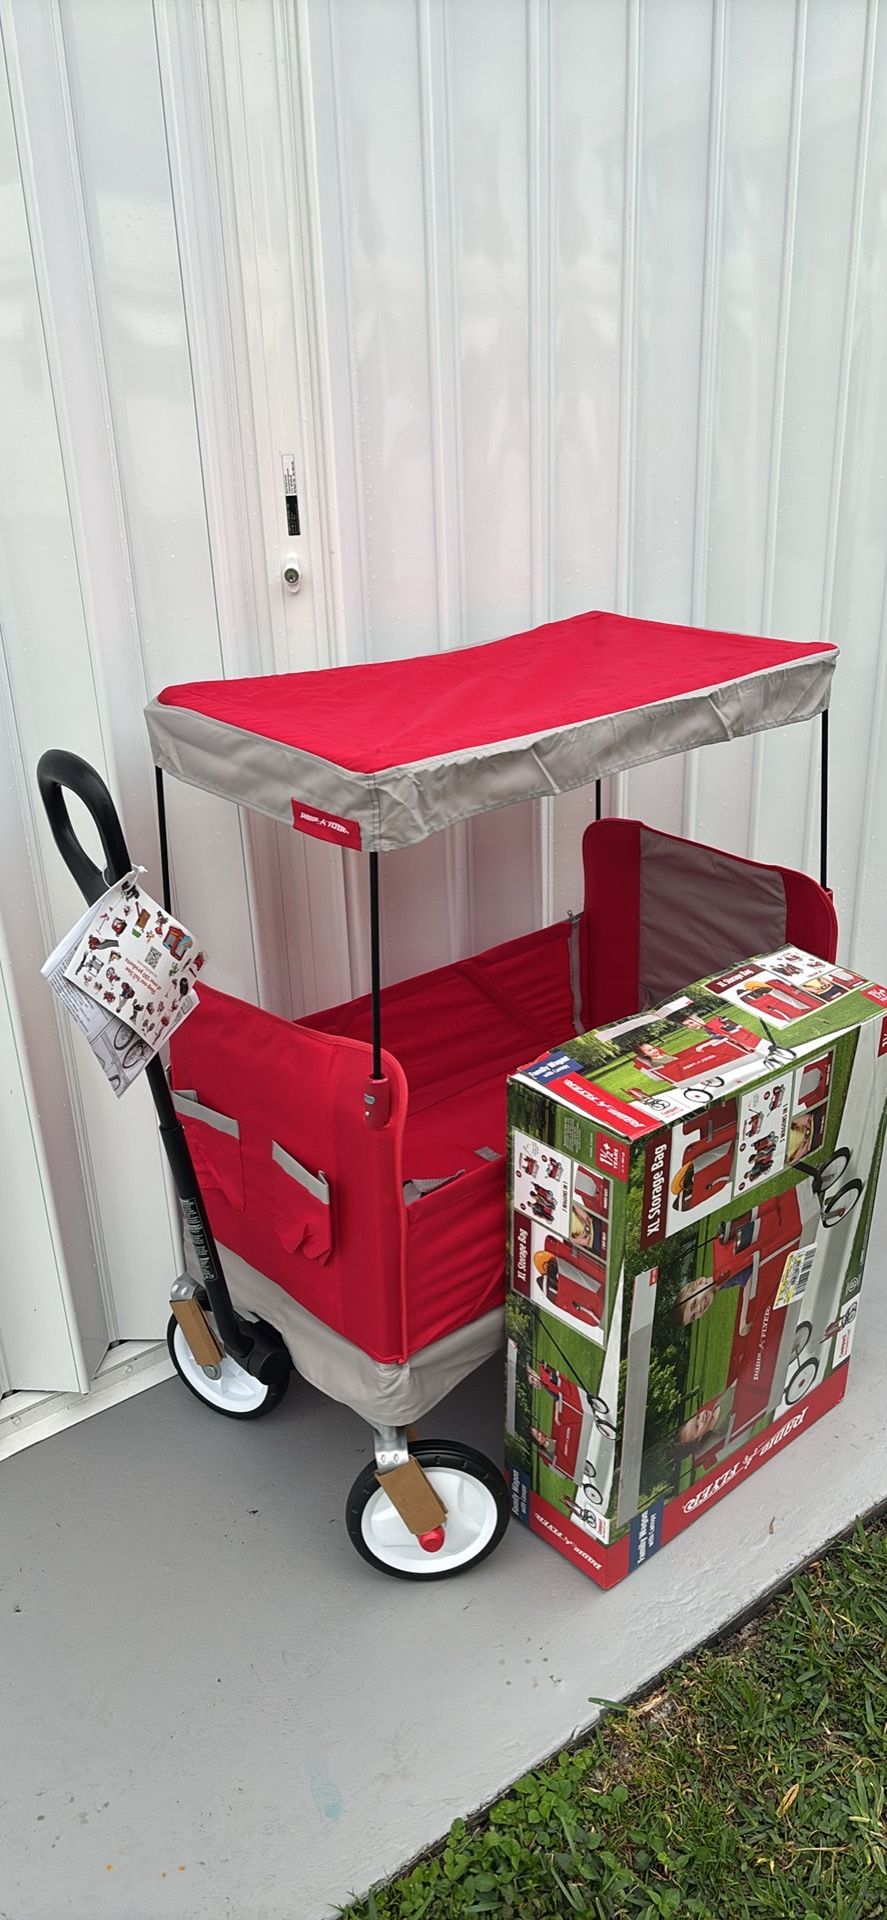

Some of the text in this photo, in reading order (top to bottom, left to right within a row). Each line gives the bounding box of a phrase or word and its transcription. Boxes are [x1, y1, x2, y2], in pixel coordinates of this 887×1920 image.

[646, 1143, 667, 1237] XL Storage Bag
[517, 1227, 529, 1244] Bag
[517, 1243, 529, 1271] Storage
[682, 1405, 809, 1513] RADIO FLYER
